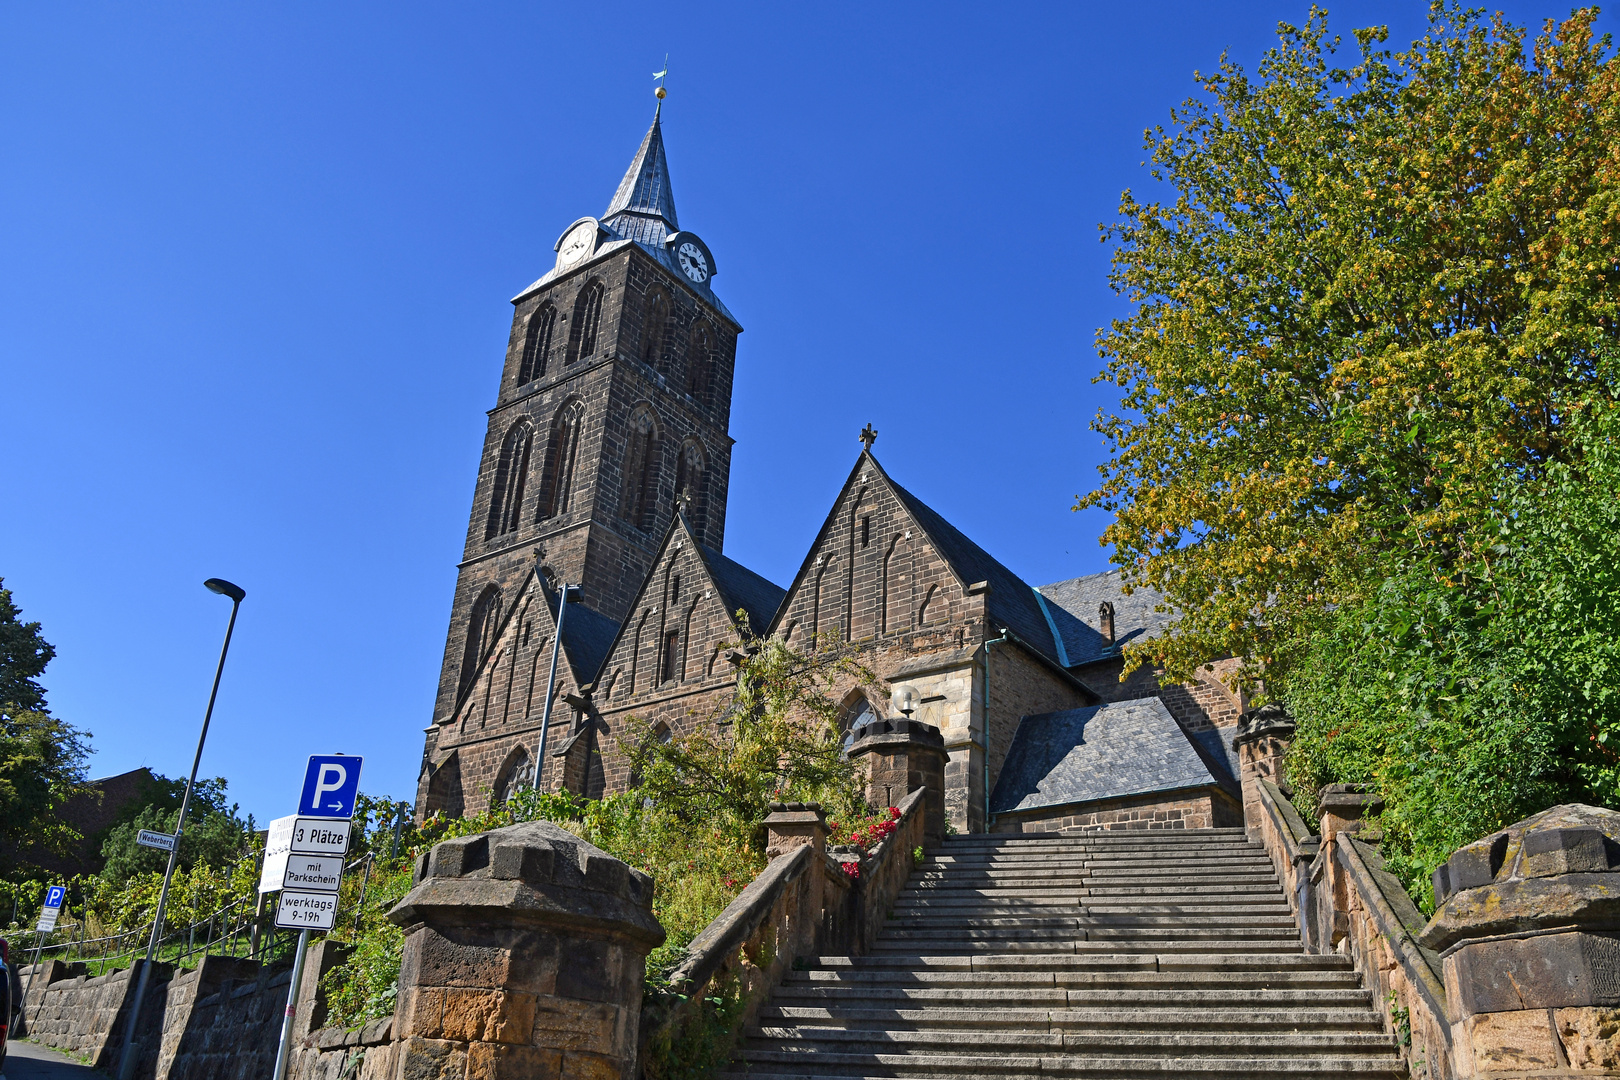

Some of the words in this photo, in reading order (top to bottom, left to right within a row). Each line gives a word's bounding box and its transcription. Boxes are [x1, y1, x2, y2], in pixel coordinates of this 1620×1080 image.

[311, 763, 347, 809] P
[142, 833, 173, 848] Weberberg
[296, 828, 305, 843] 3
[310, 828, 344, 845] Plätze
[306, 862, 322, 872] mit
[288, 872, 337, 885] Parkschein
[48, 888, 61, 905] P
[285, 897, 333, 911] werktags
[292, 910, 320, 923] 9-19h
